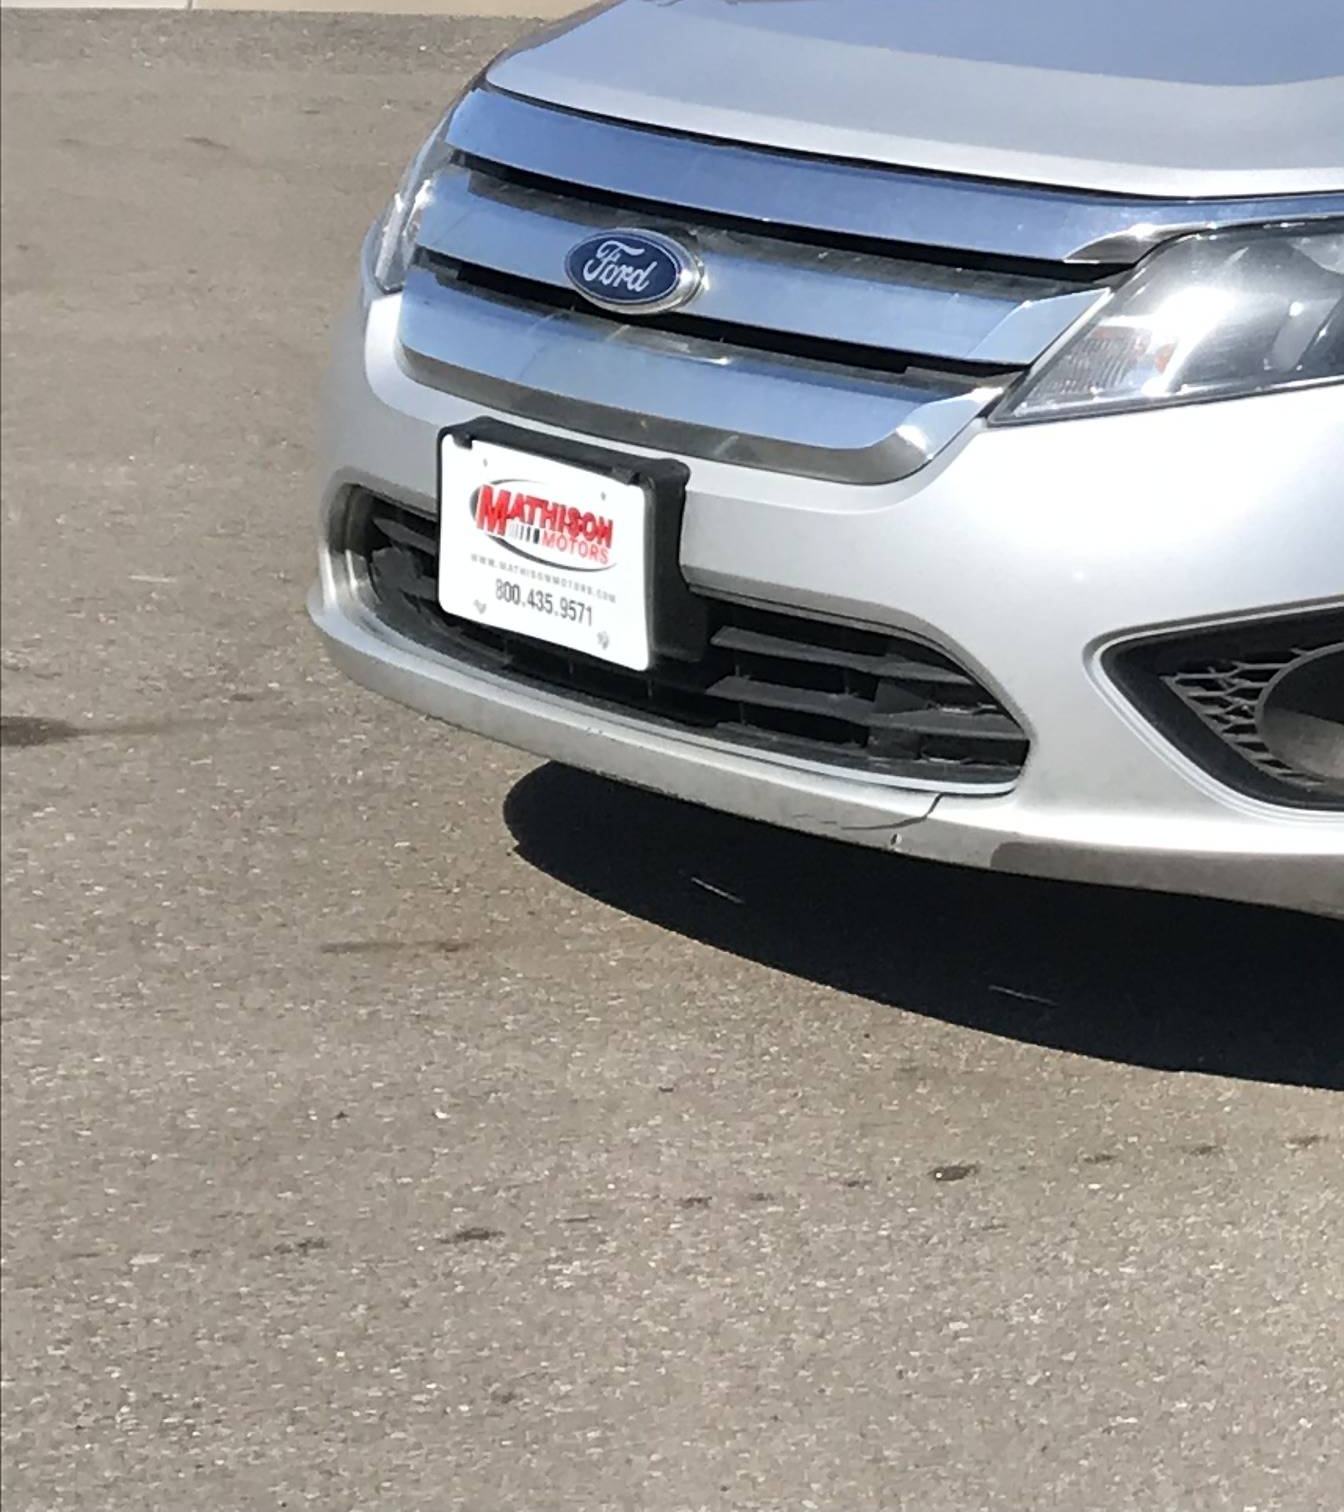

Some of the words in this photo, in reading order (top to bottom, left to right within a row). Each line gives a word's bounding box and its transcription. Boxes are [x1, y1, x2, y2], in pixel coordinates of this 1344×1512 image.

[582, 240, 658, 292] Ford
[475, 483, 614, 549] MATHISON
[541, 529, 609, 565] MOTORS
[495, 578, 593, 627] 800.435.9571
